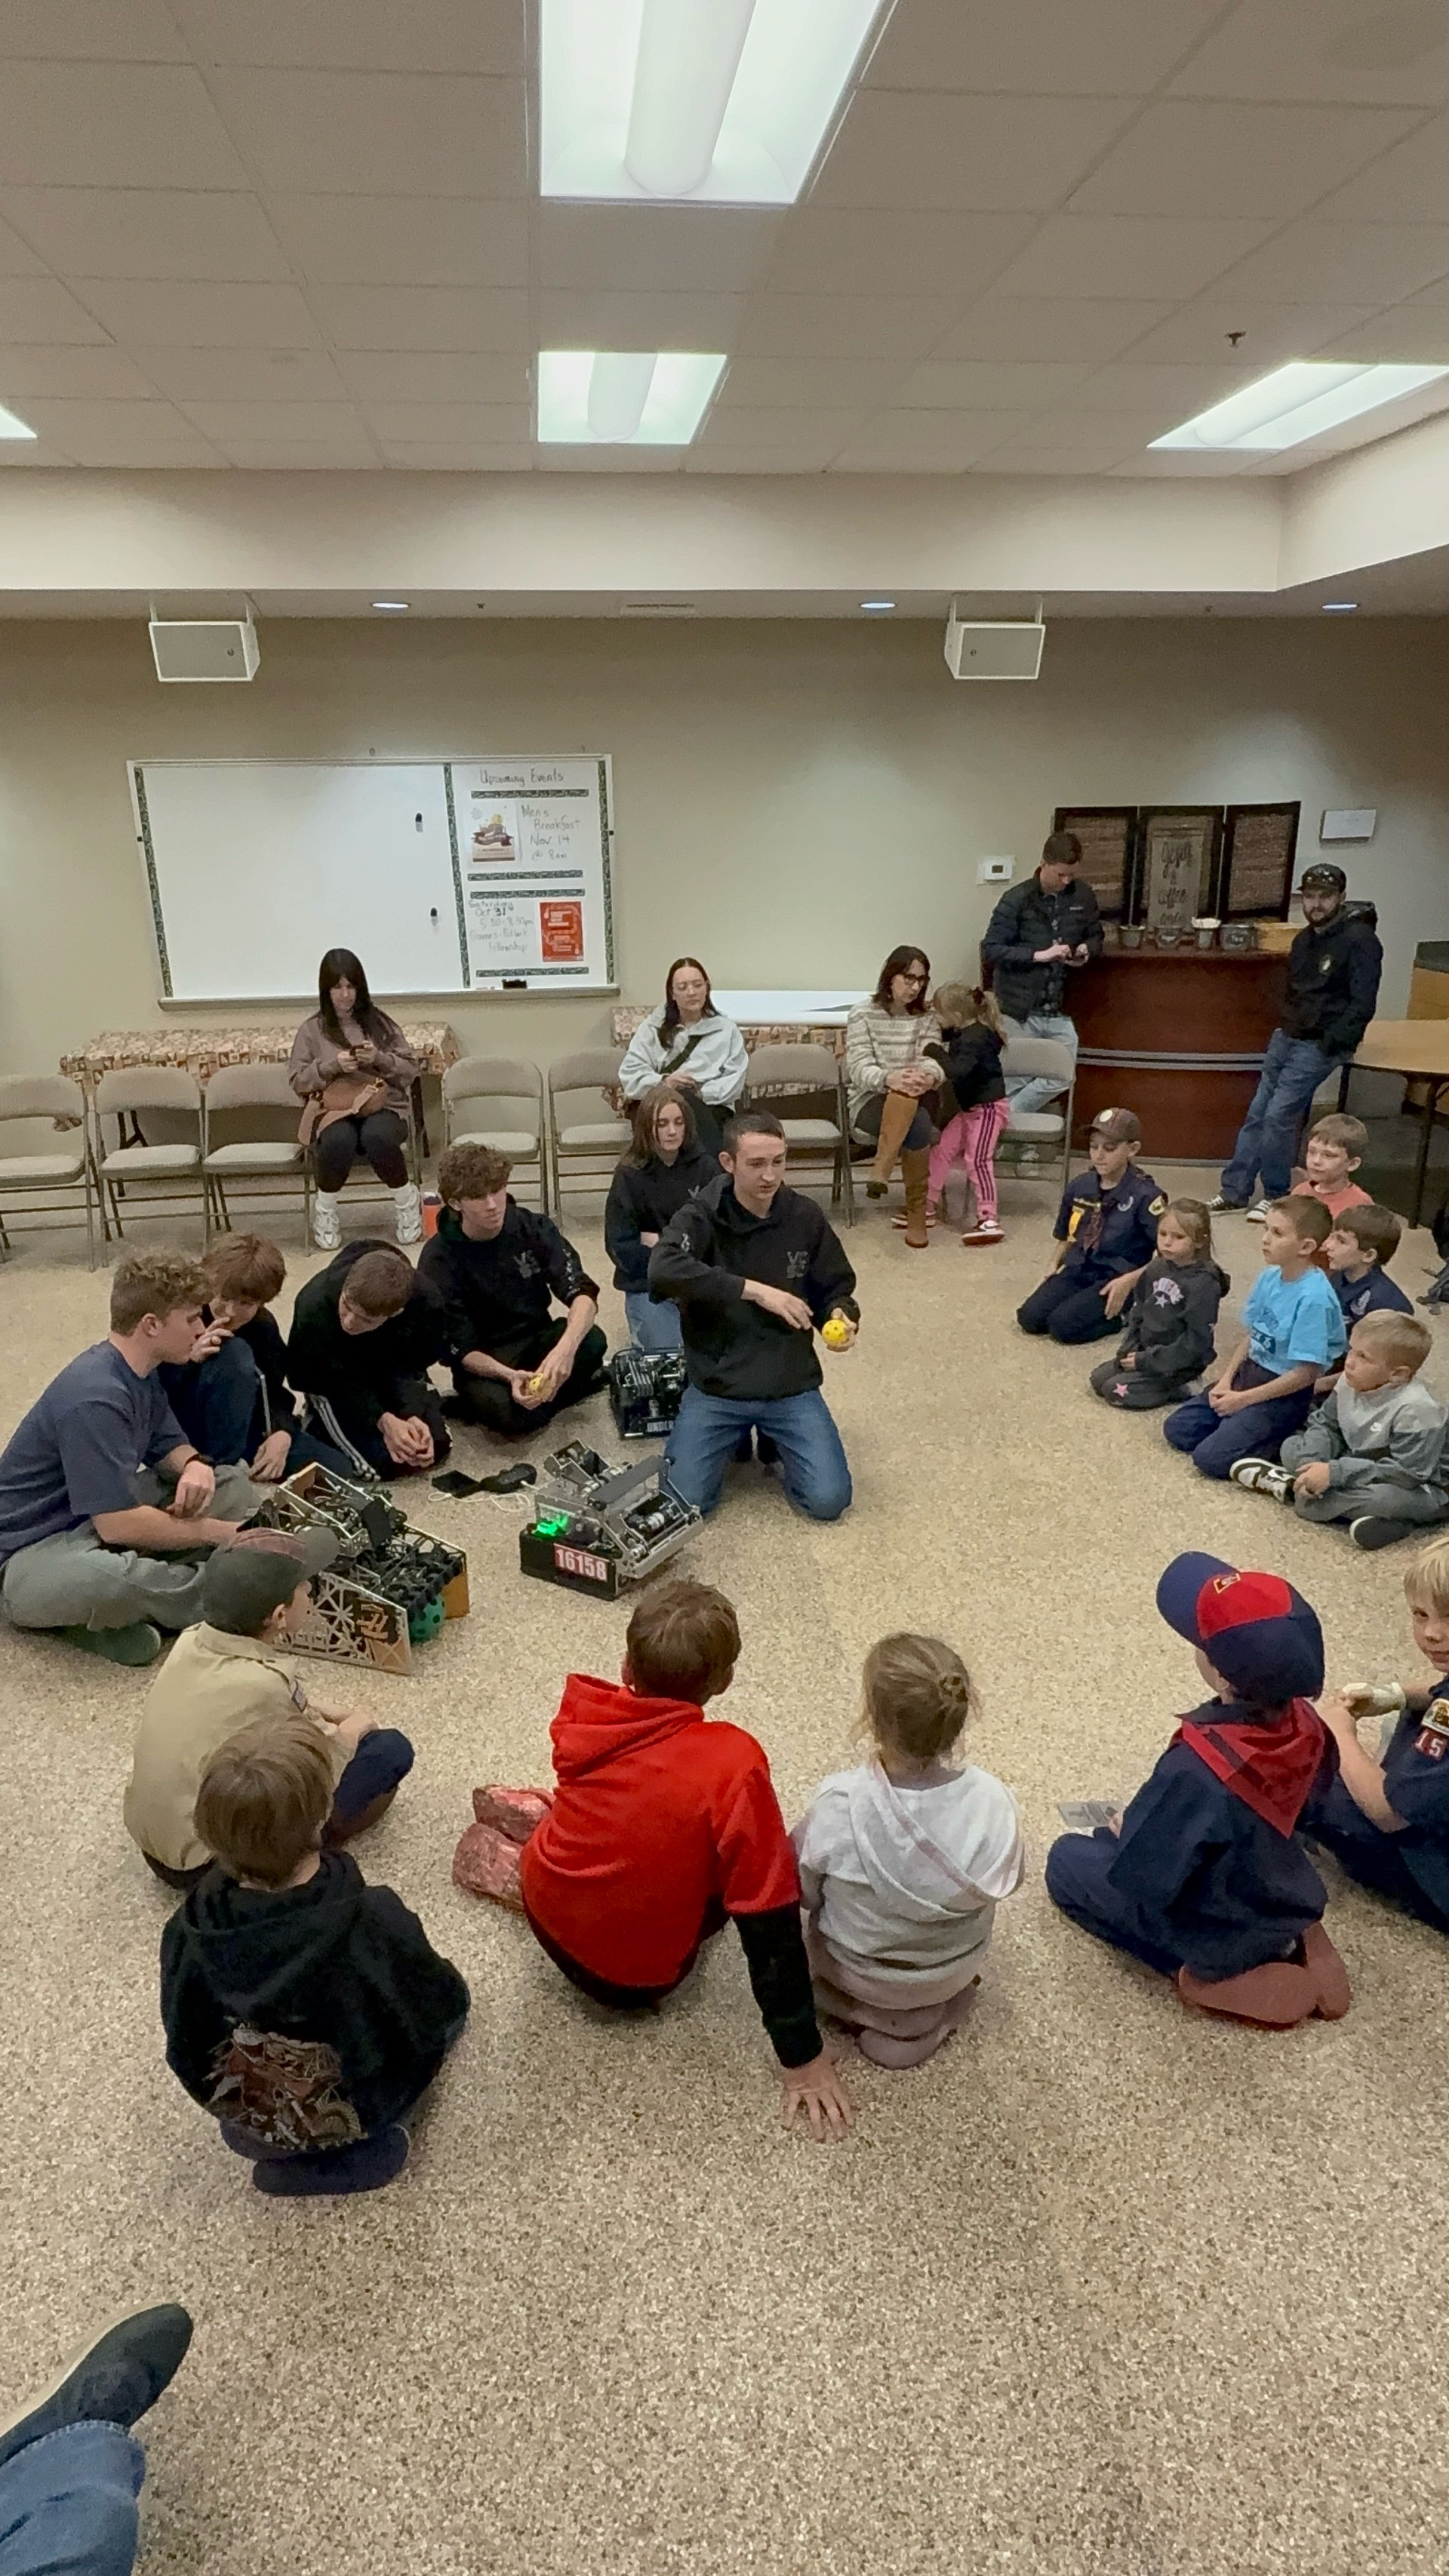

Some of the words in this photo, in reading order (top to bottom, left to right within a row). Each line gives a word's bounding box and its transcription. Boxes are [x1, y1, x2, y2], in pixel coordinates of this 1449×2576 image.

[479, 768, 526, 788] Upcoming
[531, 767, 565, 783] Events
[533, 814, 581, 831] Breakfast
[530, 832, 552, 846] Nov
[558, 834, 571, 845] 14
[468, 900, 515, 911] Saturday
[475, 908, 491, 916] Oct
[555, 1548, 608, 1582] 16158
